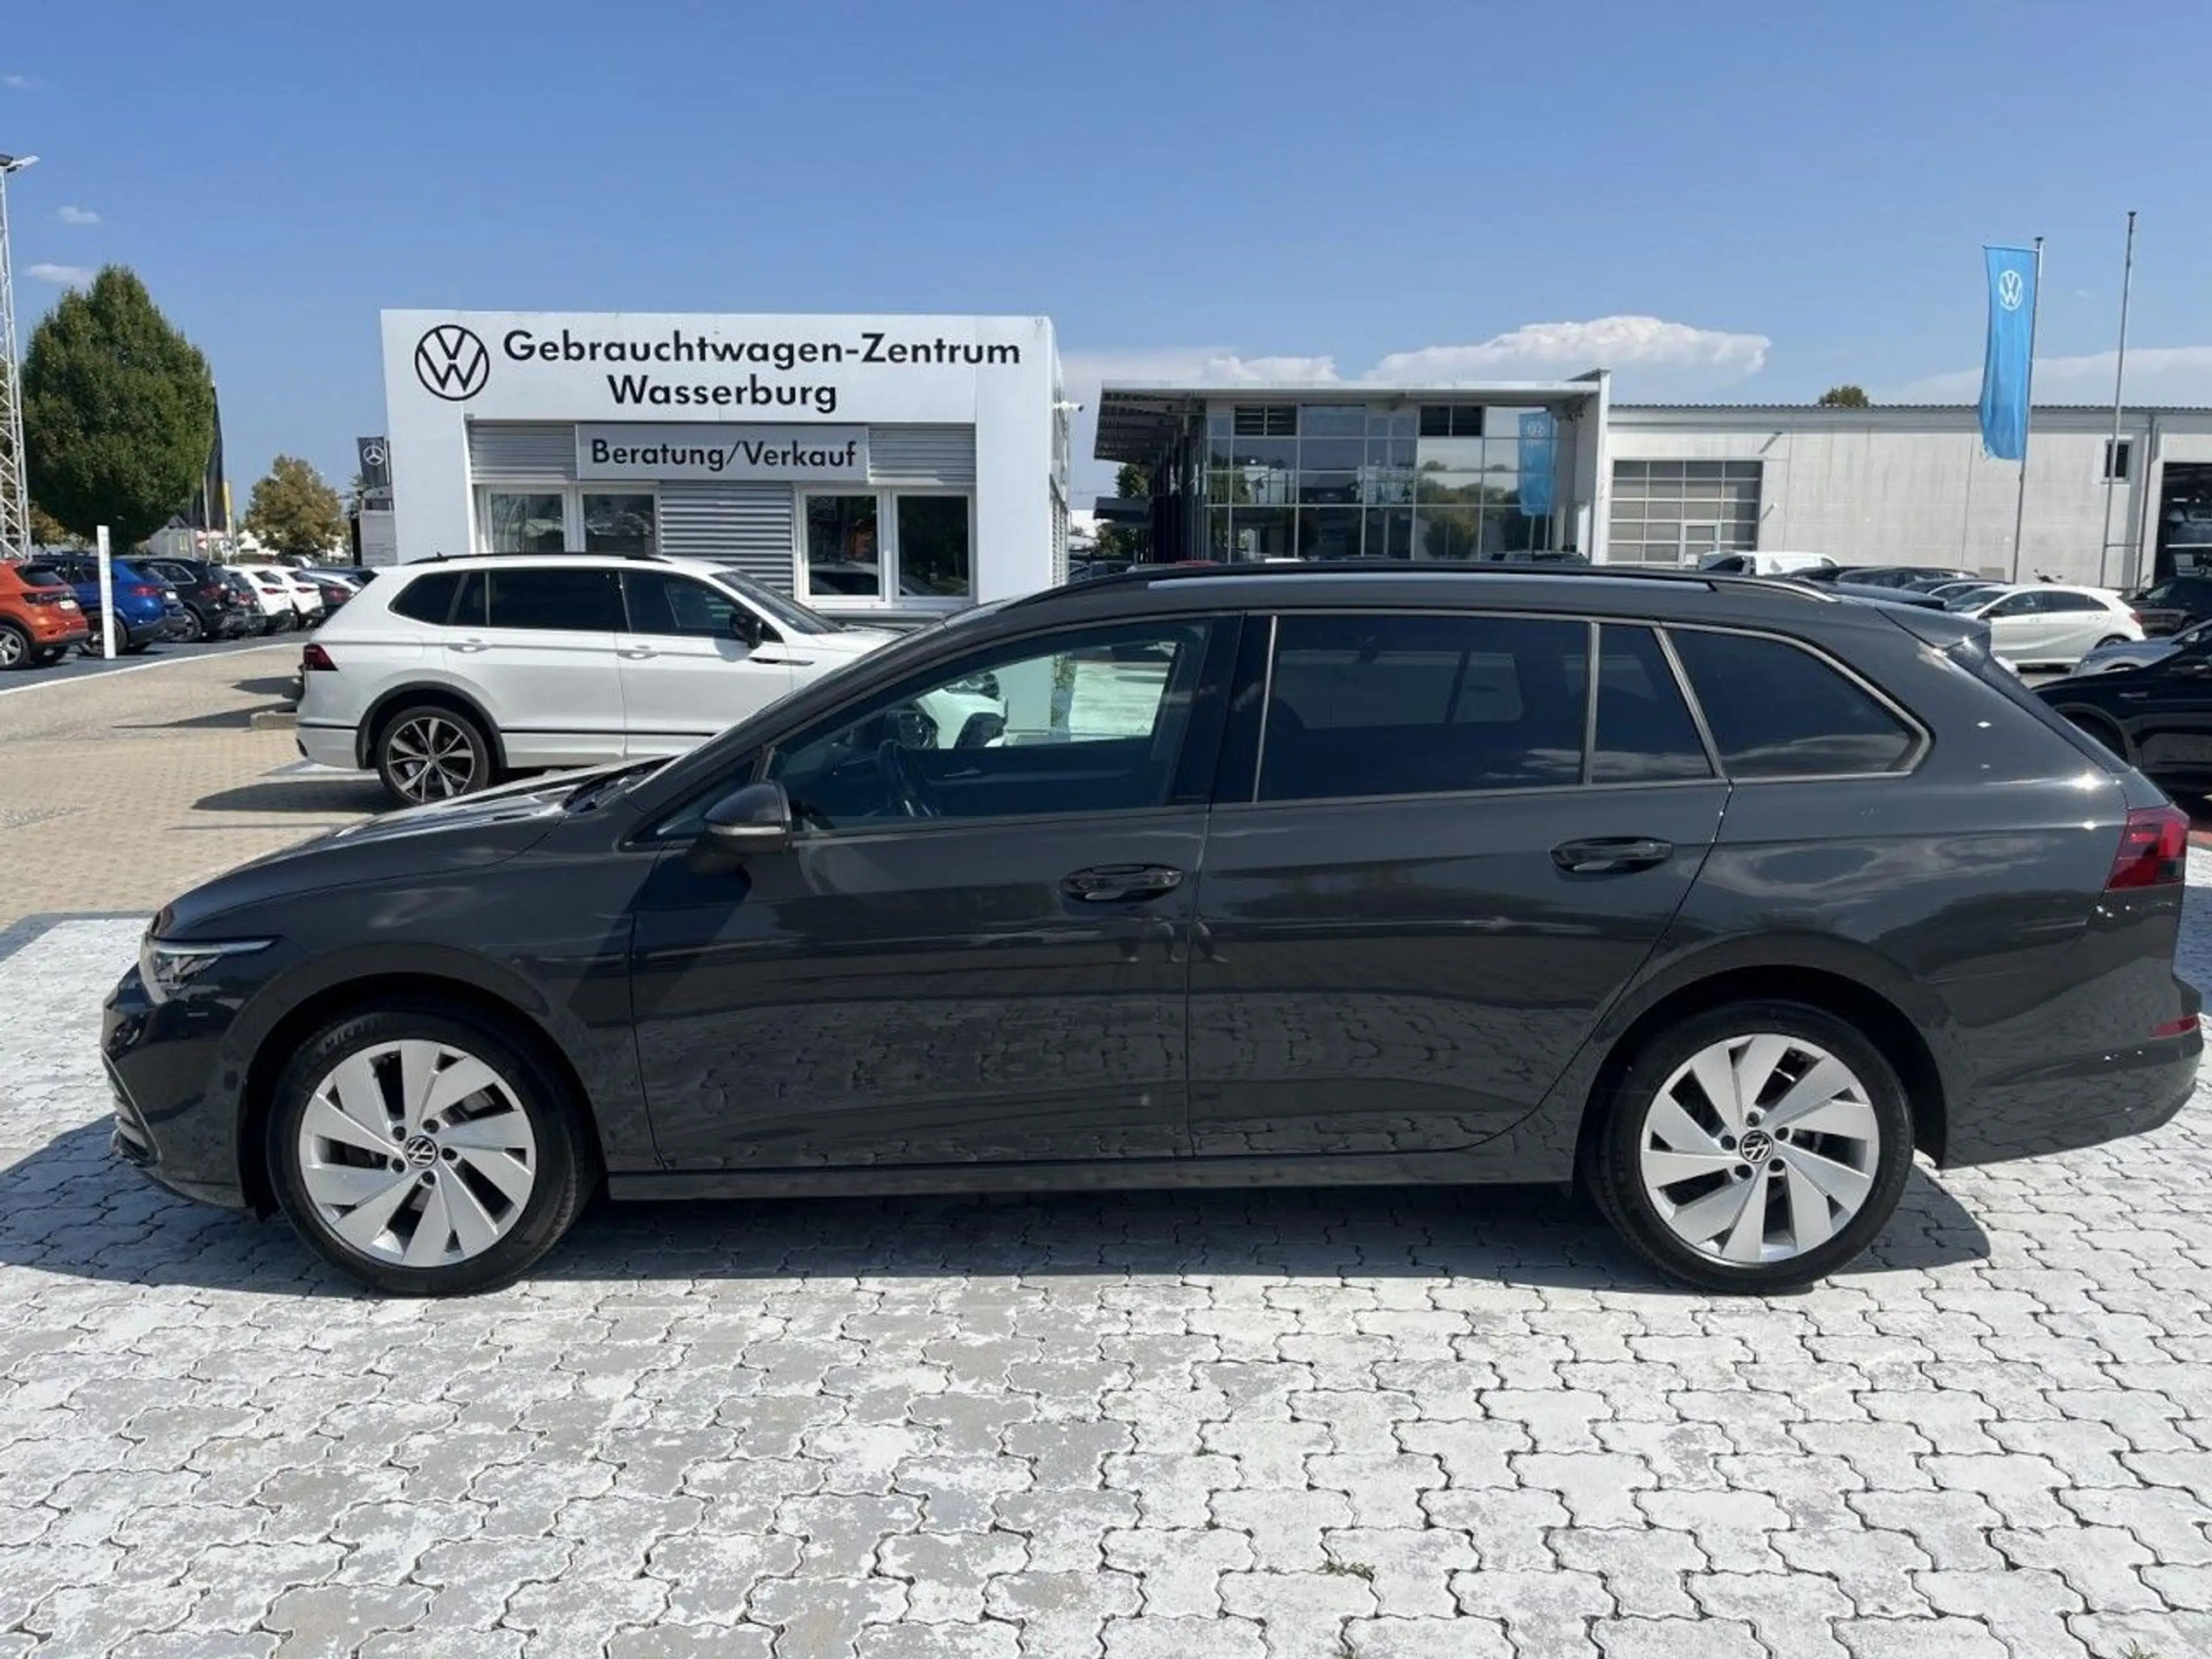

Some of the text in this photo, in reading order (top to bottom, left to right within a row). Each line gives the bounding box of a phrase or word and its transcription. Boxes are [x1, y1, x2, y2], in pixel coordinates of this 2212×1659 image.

[1999, 269, 2023, 310] VW
[415, 325, 490, 401] VW
[503, 329, 1020, 370] Gebrauchtwagen-Zentrum
[607, 373, 836, 414] Wasserburg
[591, 438, 856, 472] Beratung/Verkauf
